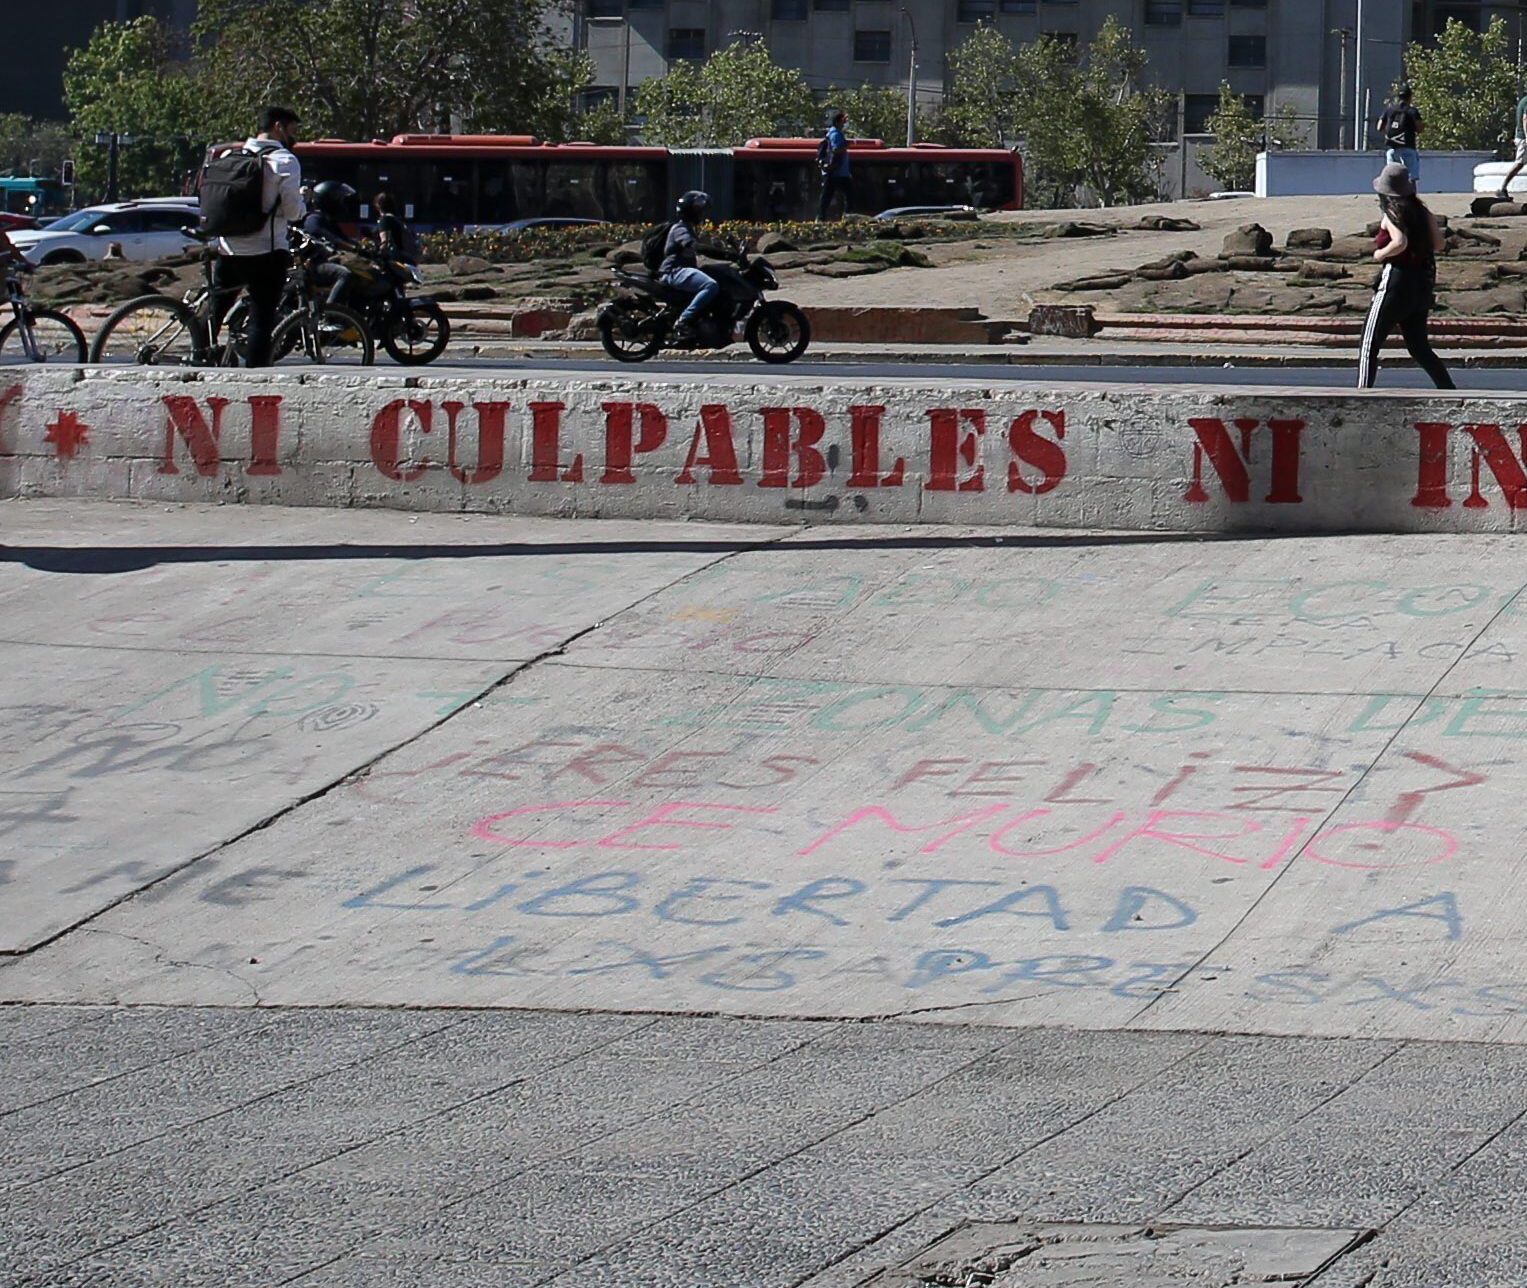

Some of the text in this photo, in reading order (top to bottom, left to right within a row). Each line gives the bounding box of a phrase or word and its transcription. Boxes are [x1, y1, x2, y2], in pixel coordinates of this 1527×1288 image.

[157, 394, 283, 477] NI
[370, 398, 1068, 495] CULPABLES
[1182, 418, 1304, 503] NI
[470, 798, 781, 851] CE
[341, 864, 1465, 942] LIBERTAD A
